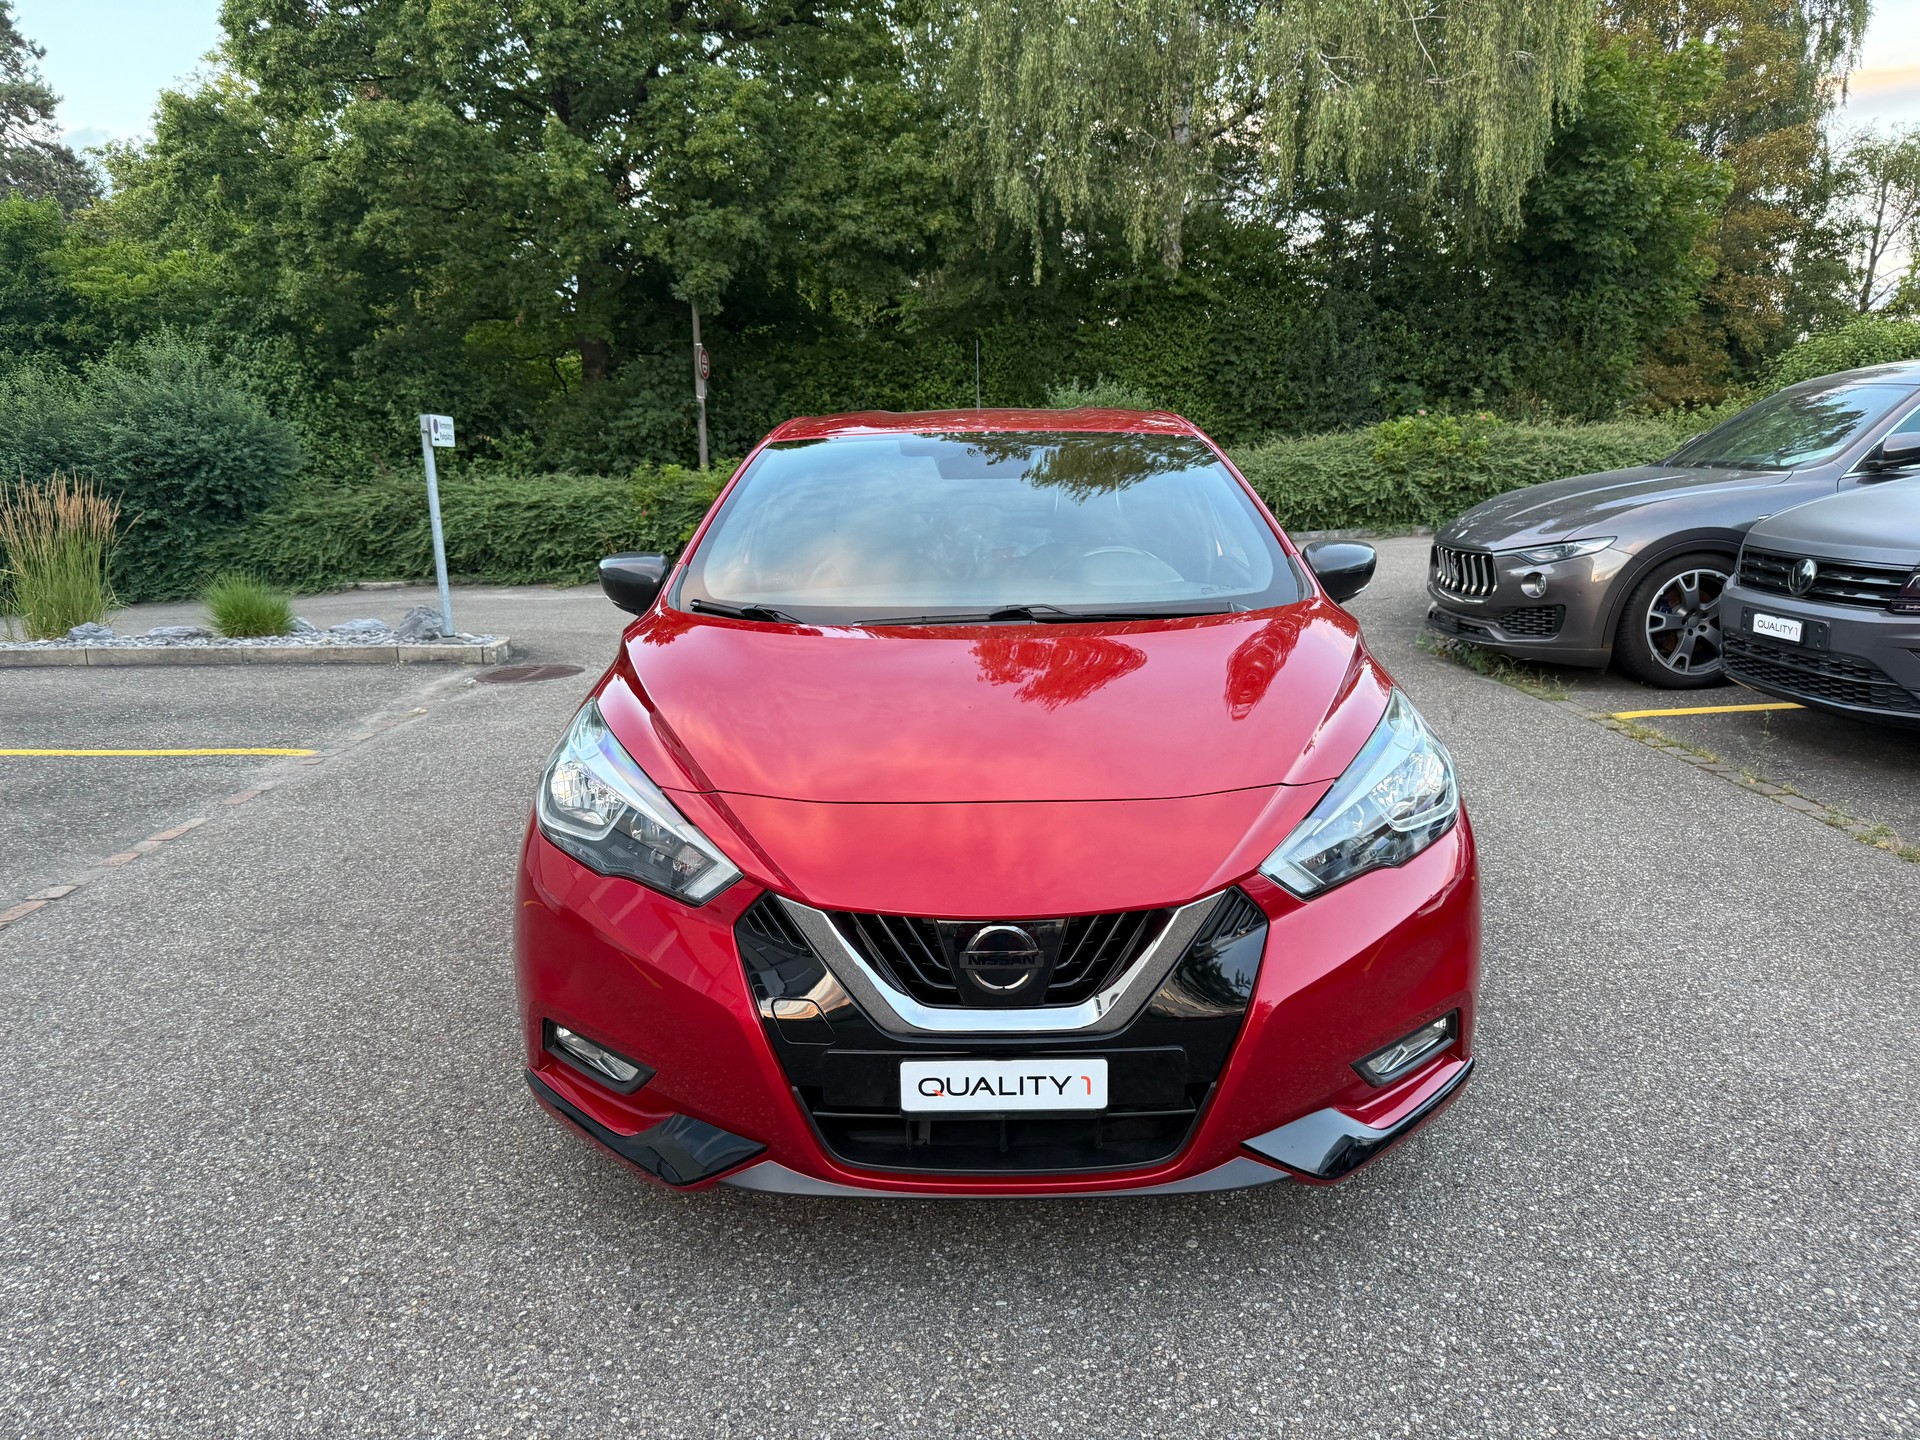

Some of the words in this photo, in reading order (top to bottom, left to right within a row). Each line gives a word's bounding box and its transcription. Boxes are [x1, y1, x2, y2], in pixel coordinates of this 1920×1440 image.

[1757, 620, 1793, 635] QUALITY
[968, 954, 1036, 966] NISSAN
[918, 1076, 1072, 1097] QUALITY
[1080, 1076, 1091, 1096] 1
